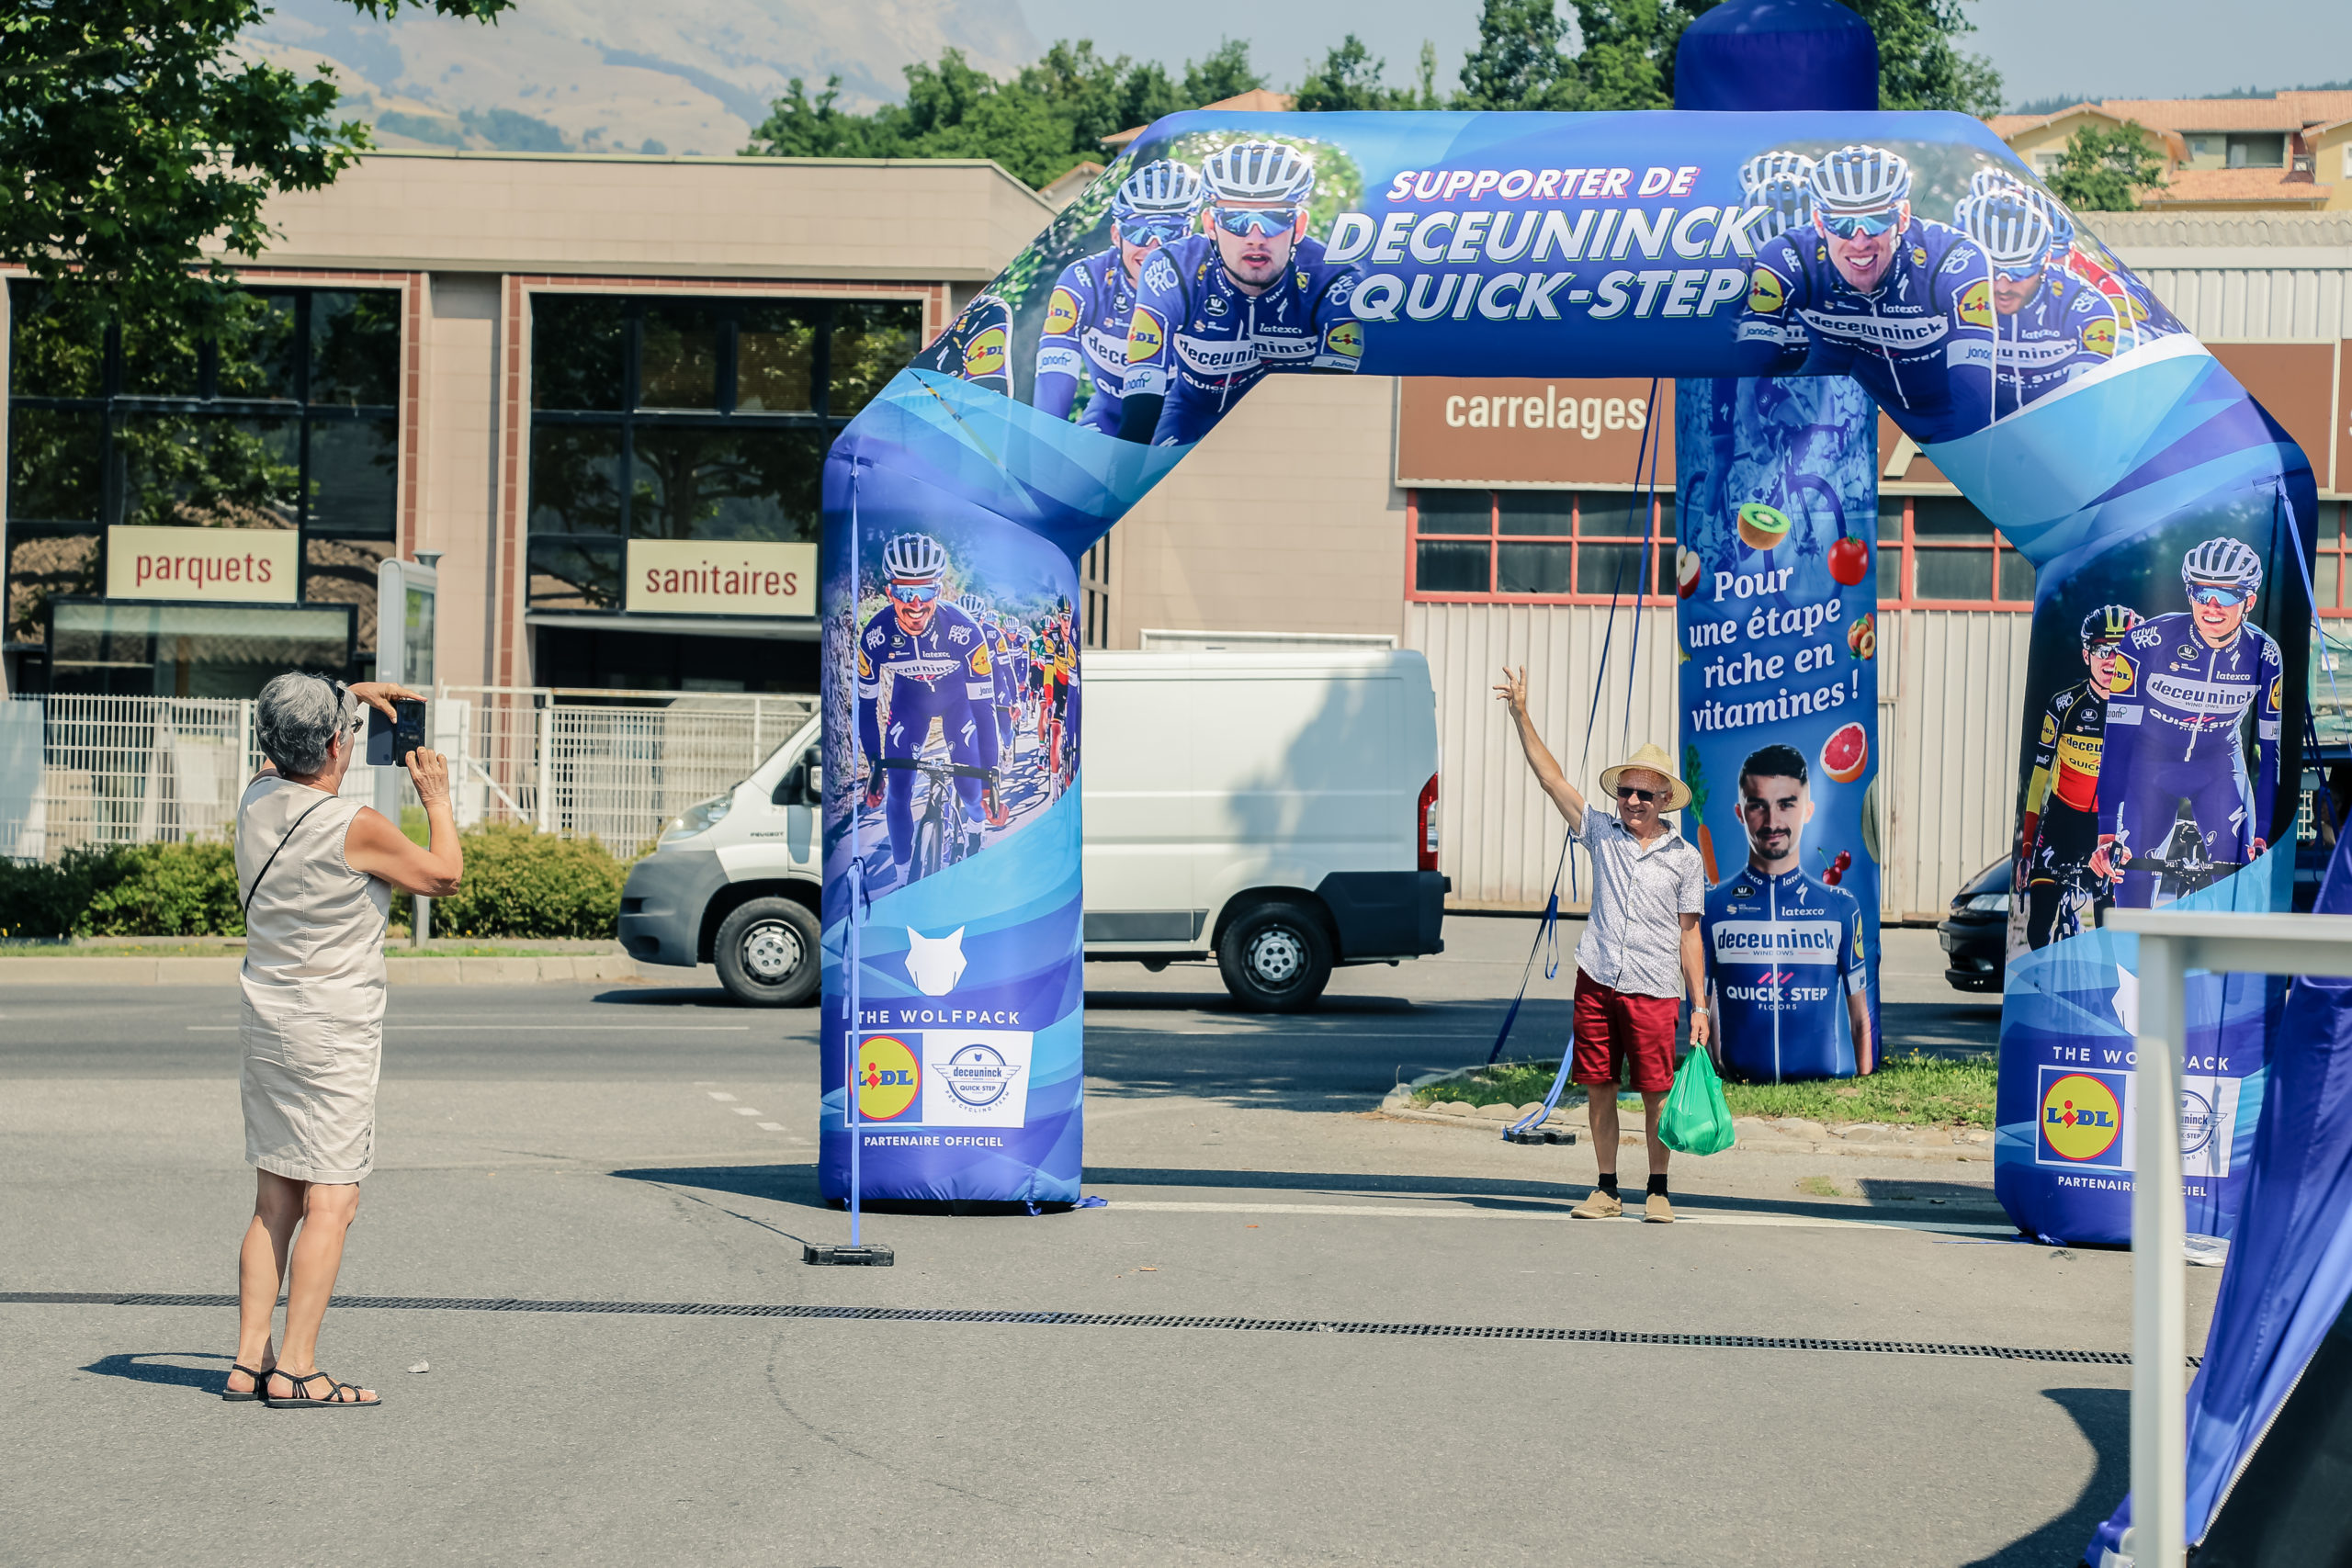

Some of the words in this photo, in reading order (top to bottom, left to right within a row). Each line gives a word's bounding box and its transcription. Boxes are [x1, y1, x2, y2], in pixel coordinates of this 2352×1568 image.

[1385, 168, 1633, 202] SUPPORTER
[1637, 166, 1701, 197] DE
[1324, 205, 1773, 265] DECEUNINCK
[1349, 268, 1748, 322] QUICK-STEP
[1445, 385, 1647, 440] carrelages
[136, 552, 273, 589] parquets
[646, 560, 797, 596] sanitaires
[1713, 566, 1795, 603] Pour
[1689, 618, 1738, 648] une
[1747, 598, 1841, 640] étape
[2132, 633, 2162, 650] PRO
[1703, 650, 1784, 688] riche
[1794, 643, 1835, 673] en
[2216, 671, 2251, 681] latexco
[1691, 681, 1846, 732] vitamines
[1781, 907, 1825, 917] latexco
[1717, 928, 1835, 950] deceuninck
[1726, 986, 1783, 1002] QUICK
[858, 1010, 889, 1024] THE
[900, 1010, 1020, 1025] WOLFPACK
[954, 1066, 1002, 1077] deceuninck
[2052, 1045, 2091, 1062] THE
[864, 1135, 940, 1147] PARTENAIRE
[944, 1136, 1004, 1147] OFFICIEL
